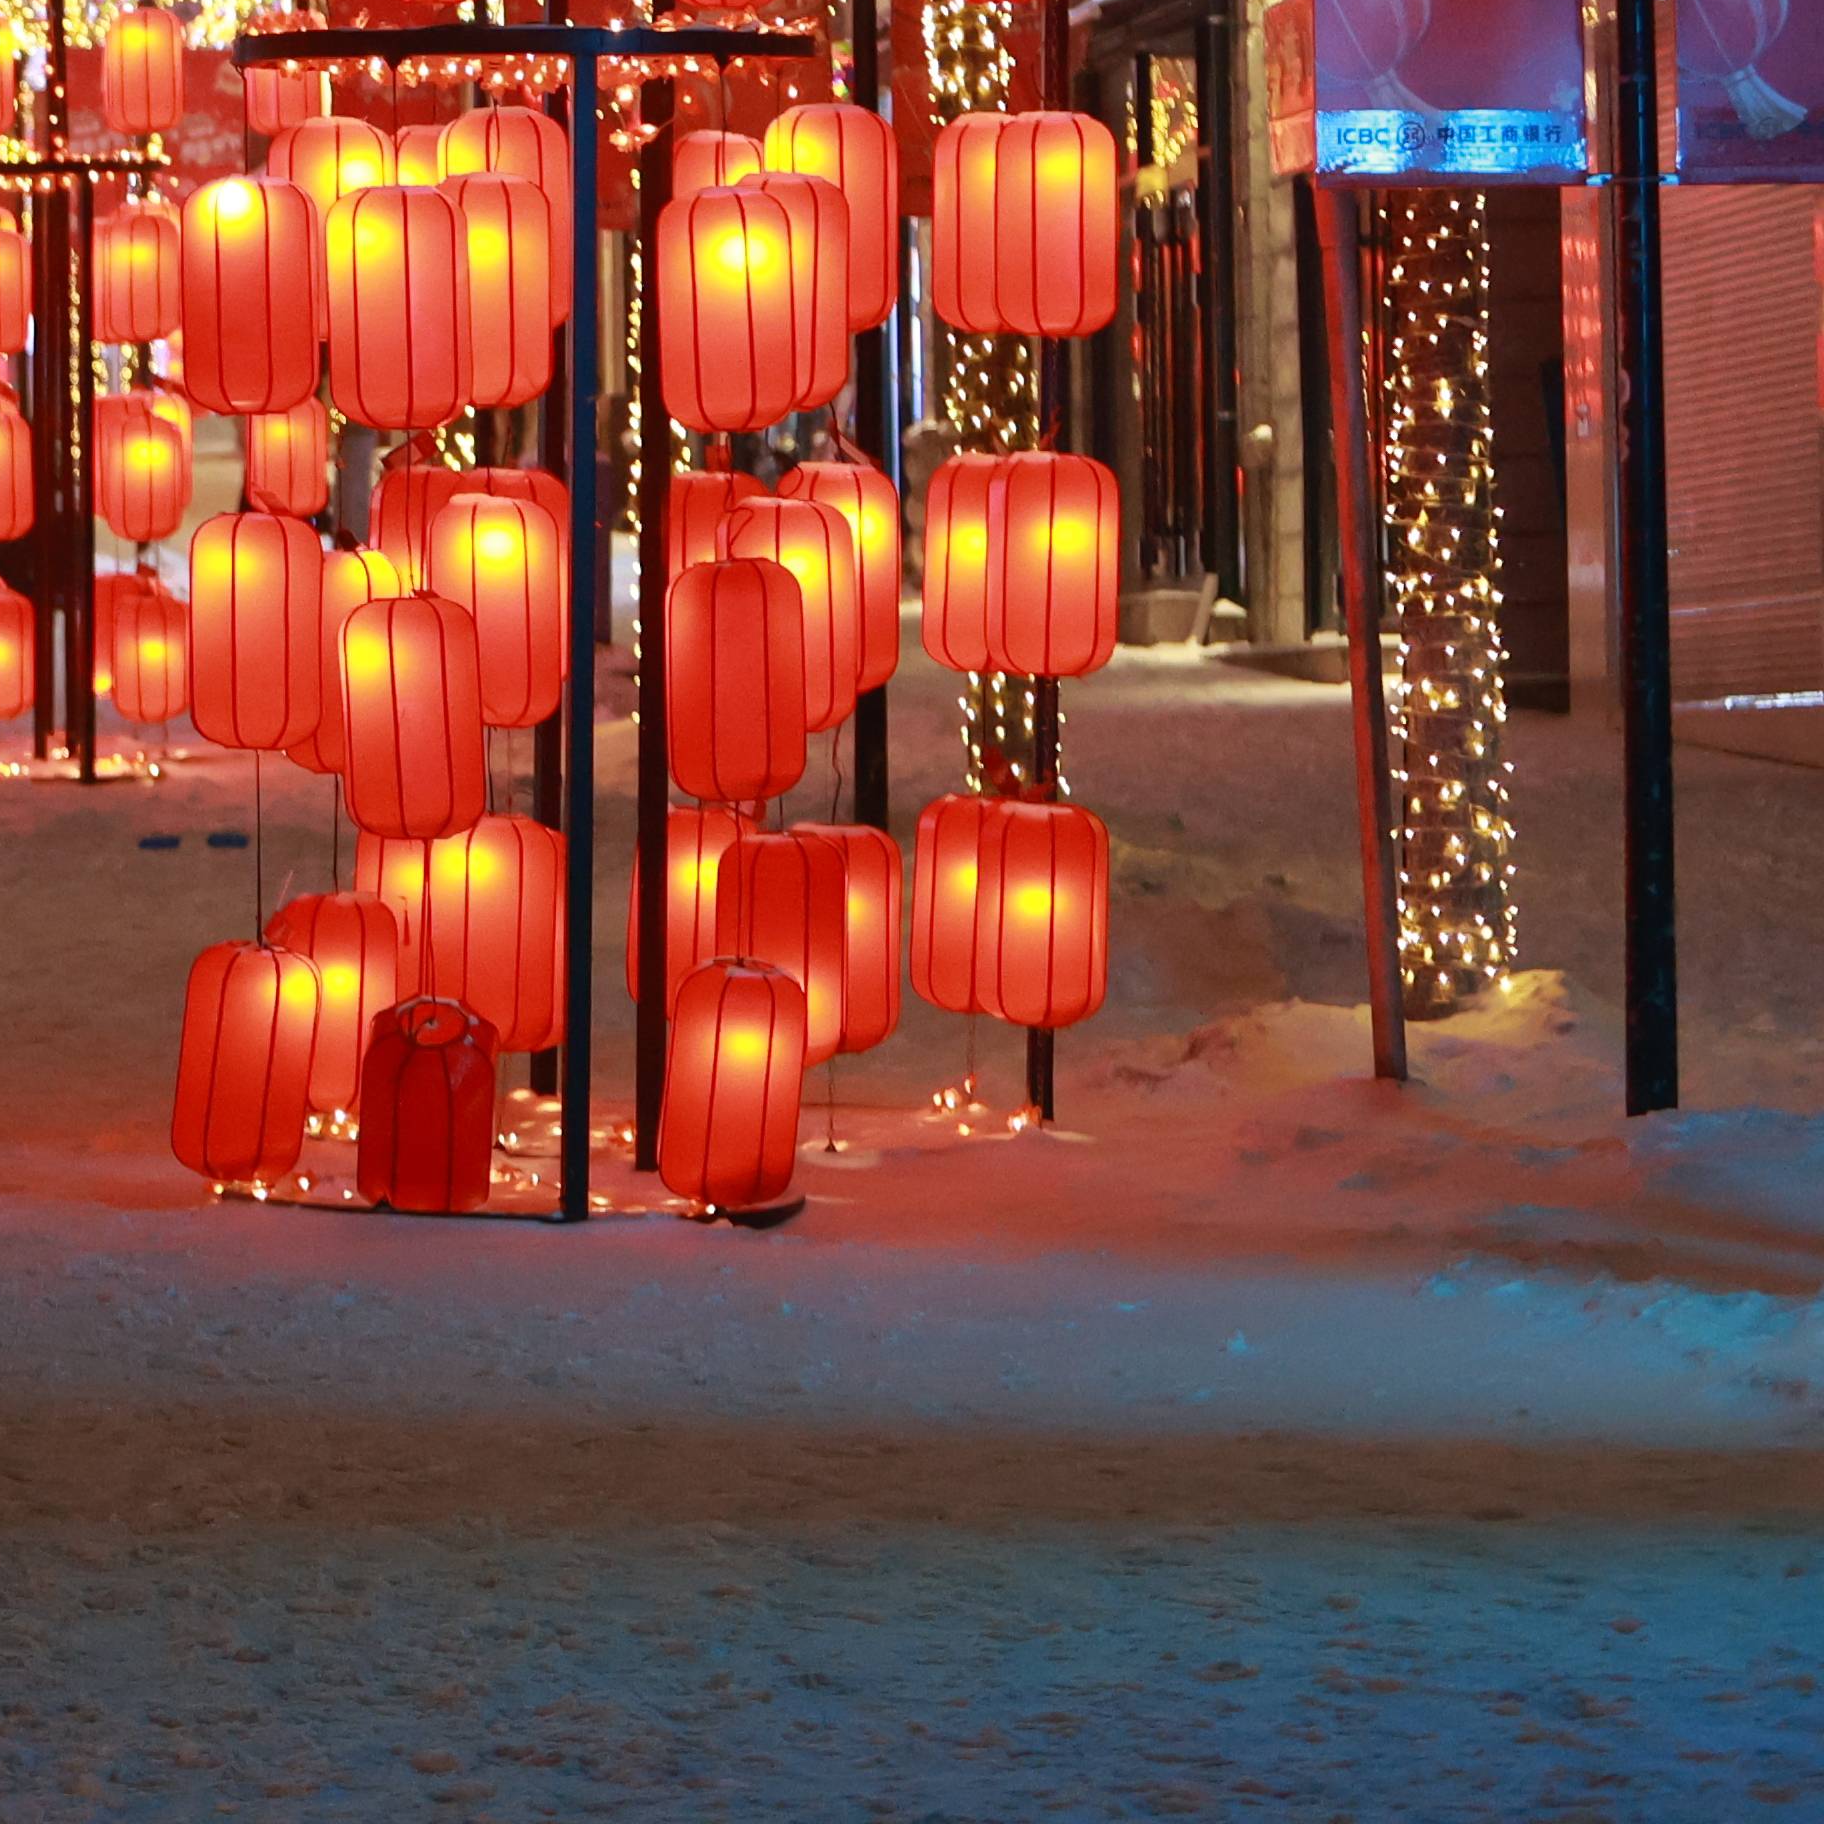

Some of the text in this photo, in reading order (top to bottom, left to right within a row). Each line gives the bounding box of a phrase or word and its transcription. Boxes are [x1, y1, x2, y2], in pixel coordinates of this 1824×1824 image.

[1337, 124, 1562, 145] ICBC 中国工商银行
